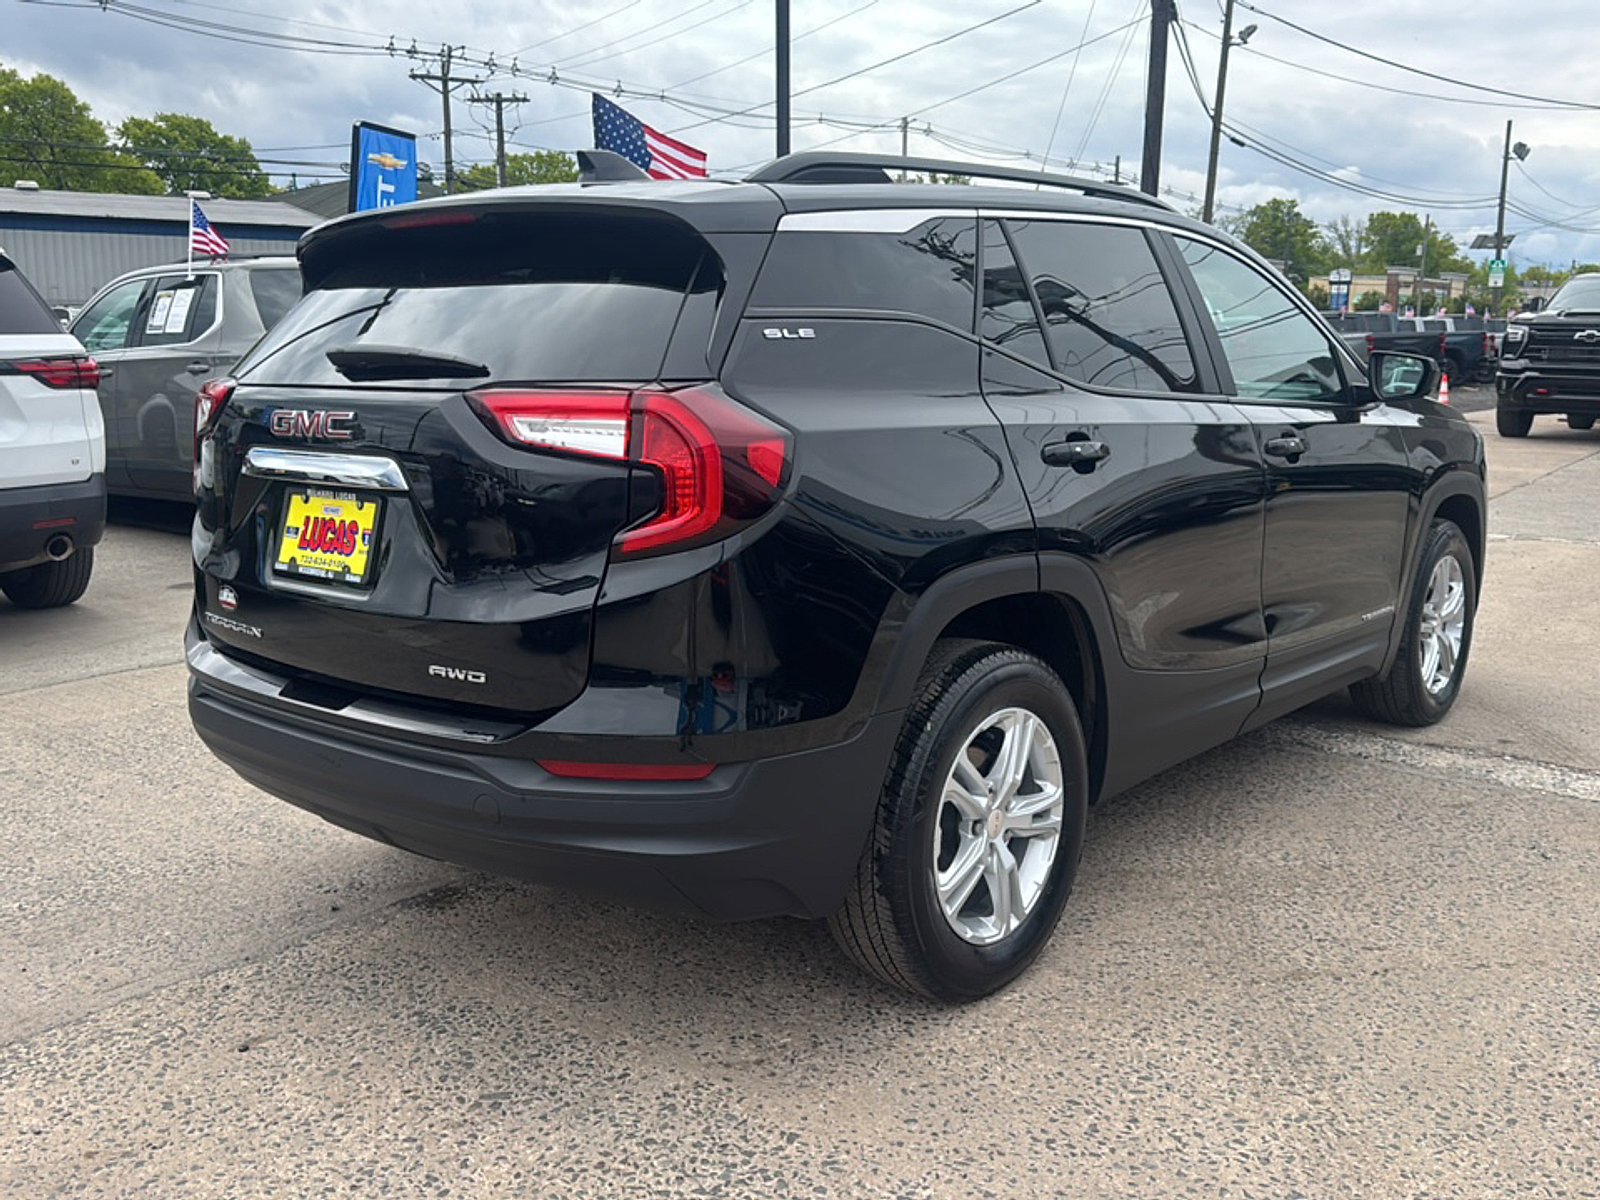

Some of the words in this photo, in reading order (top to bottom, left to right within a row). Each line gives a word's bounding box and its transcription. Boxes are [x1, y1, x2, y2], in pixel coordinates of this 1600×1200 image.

[763, 327, 816, 338] SLE
[270, 408, 354, 438] GMC
[298, 515, 359, 557] LUCAS
[428, 664, 487, 684] AWD
